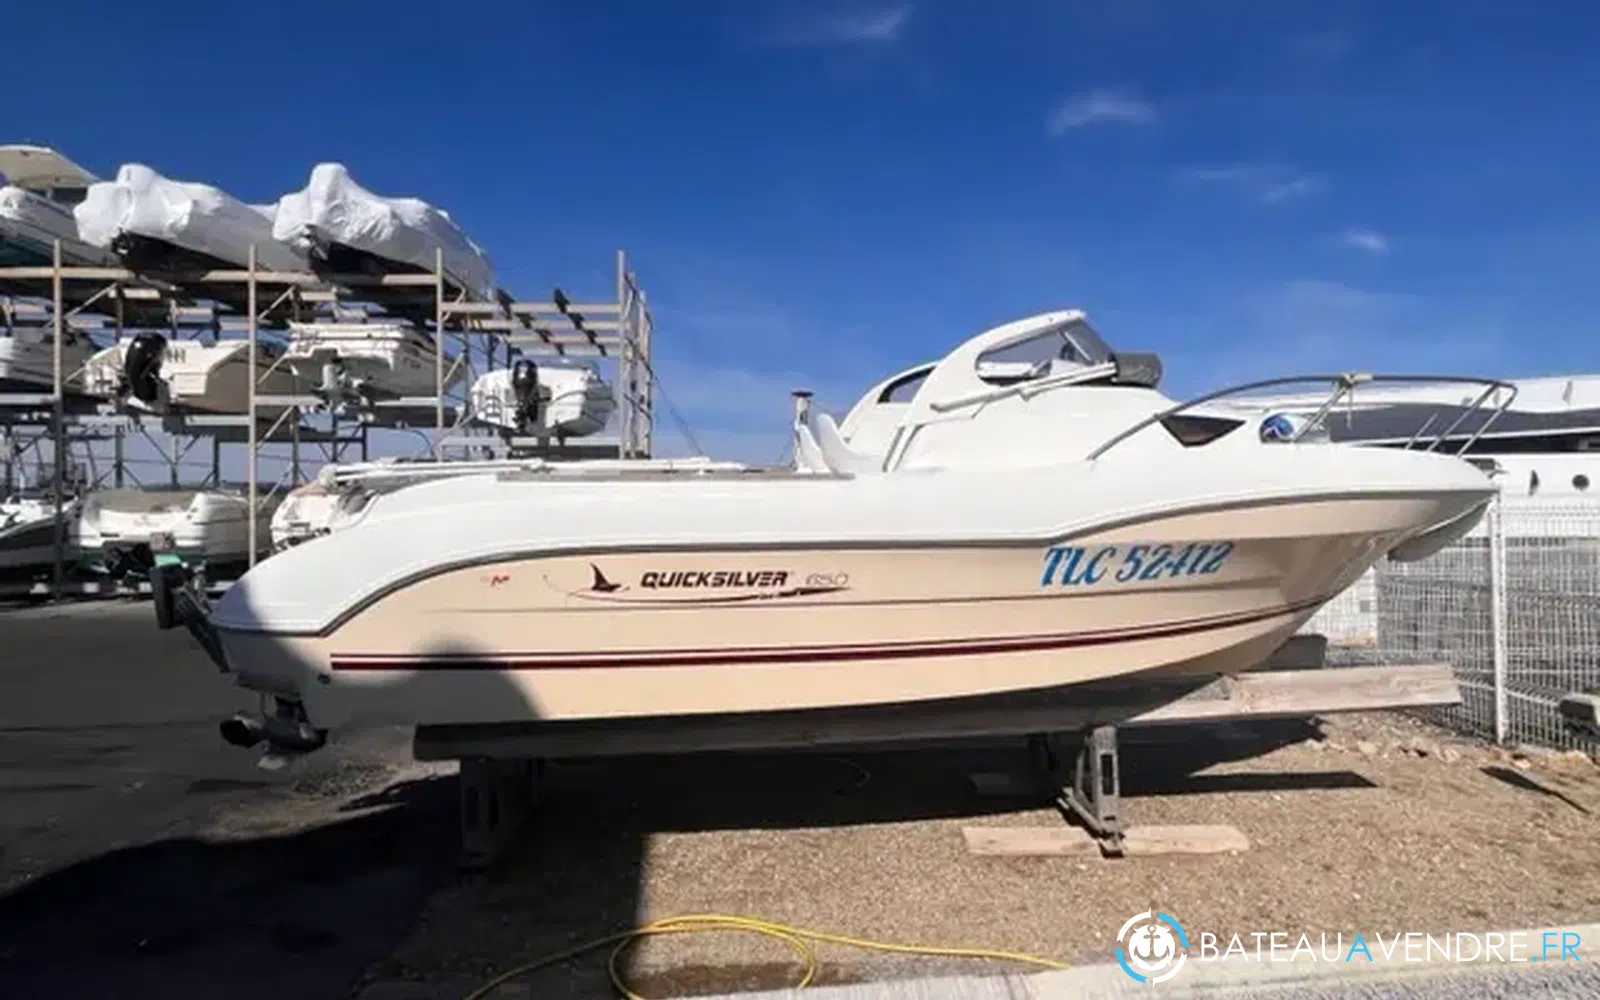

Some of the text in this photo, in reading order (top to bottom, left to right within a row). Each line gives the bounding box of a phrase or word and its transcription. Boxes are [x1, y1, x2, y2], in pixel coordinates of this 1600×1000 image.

[1041, 540, 1234, 587] TLC 52412
[641, 571, 789, 589] QUICKSILVER
